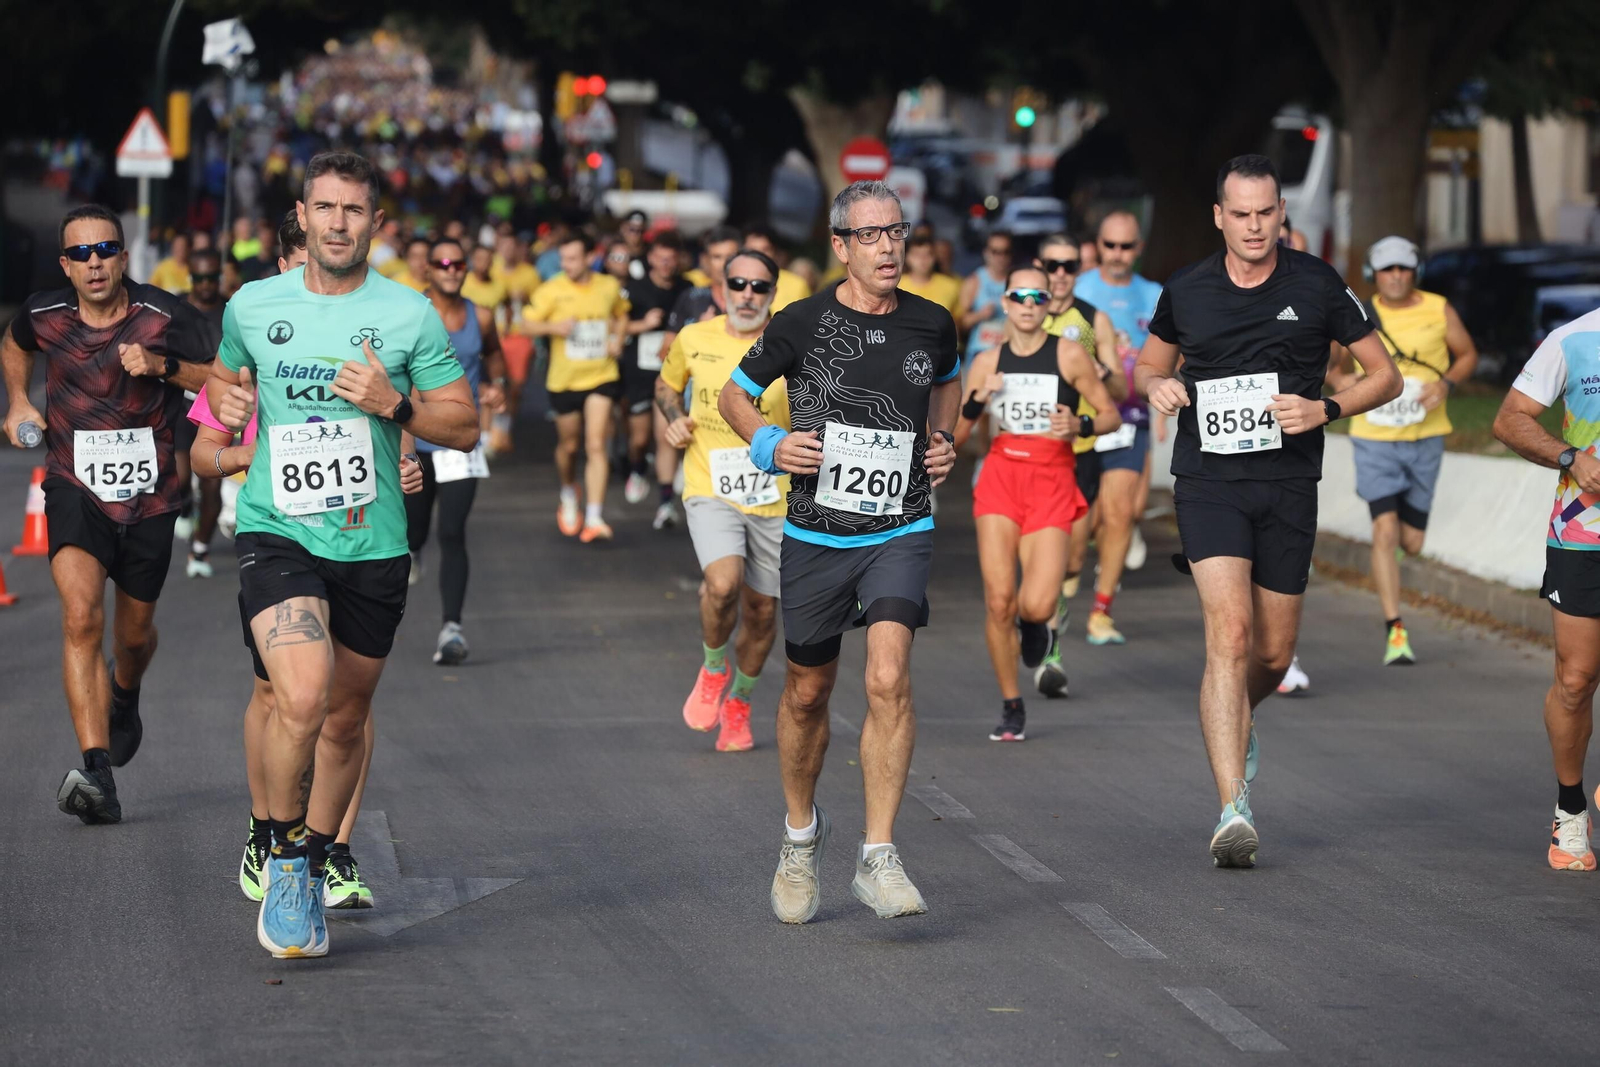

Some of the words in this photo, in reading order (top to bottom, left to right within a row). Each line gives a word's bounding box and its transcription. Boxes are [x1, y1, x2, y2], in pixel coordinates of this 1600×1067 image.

[275, 360, 337, 381] Islatra
[1581, 374, 1600, 385] Má
[998, 402, 1050, 420] 1555
[1206, 407, 1275, 437] 8584
[277, 445, 319, 453] CARRERA
[830, 444, 869, 455] CARRERA
[84, 460, 152, 486] 1525
[282, 455, 368, 493] 8613
[719, 472, 772, 495] 8472
[829, 463, 903, 498] 1260
